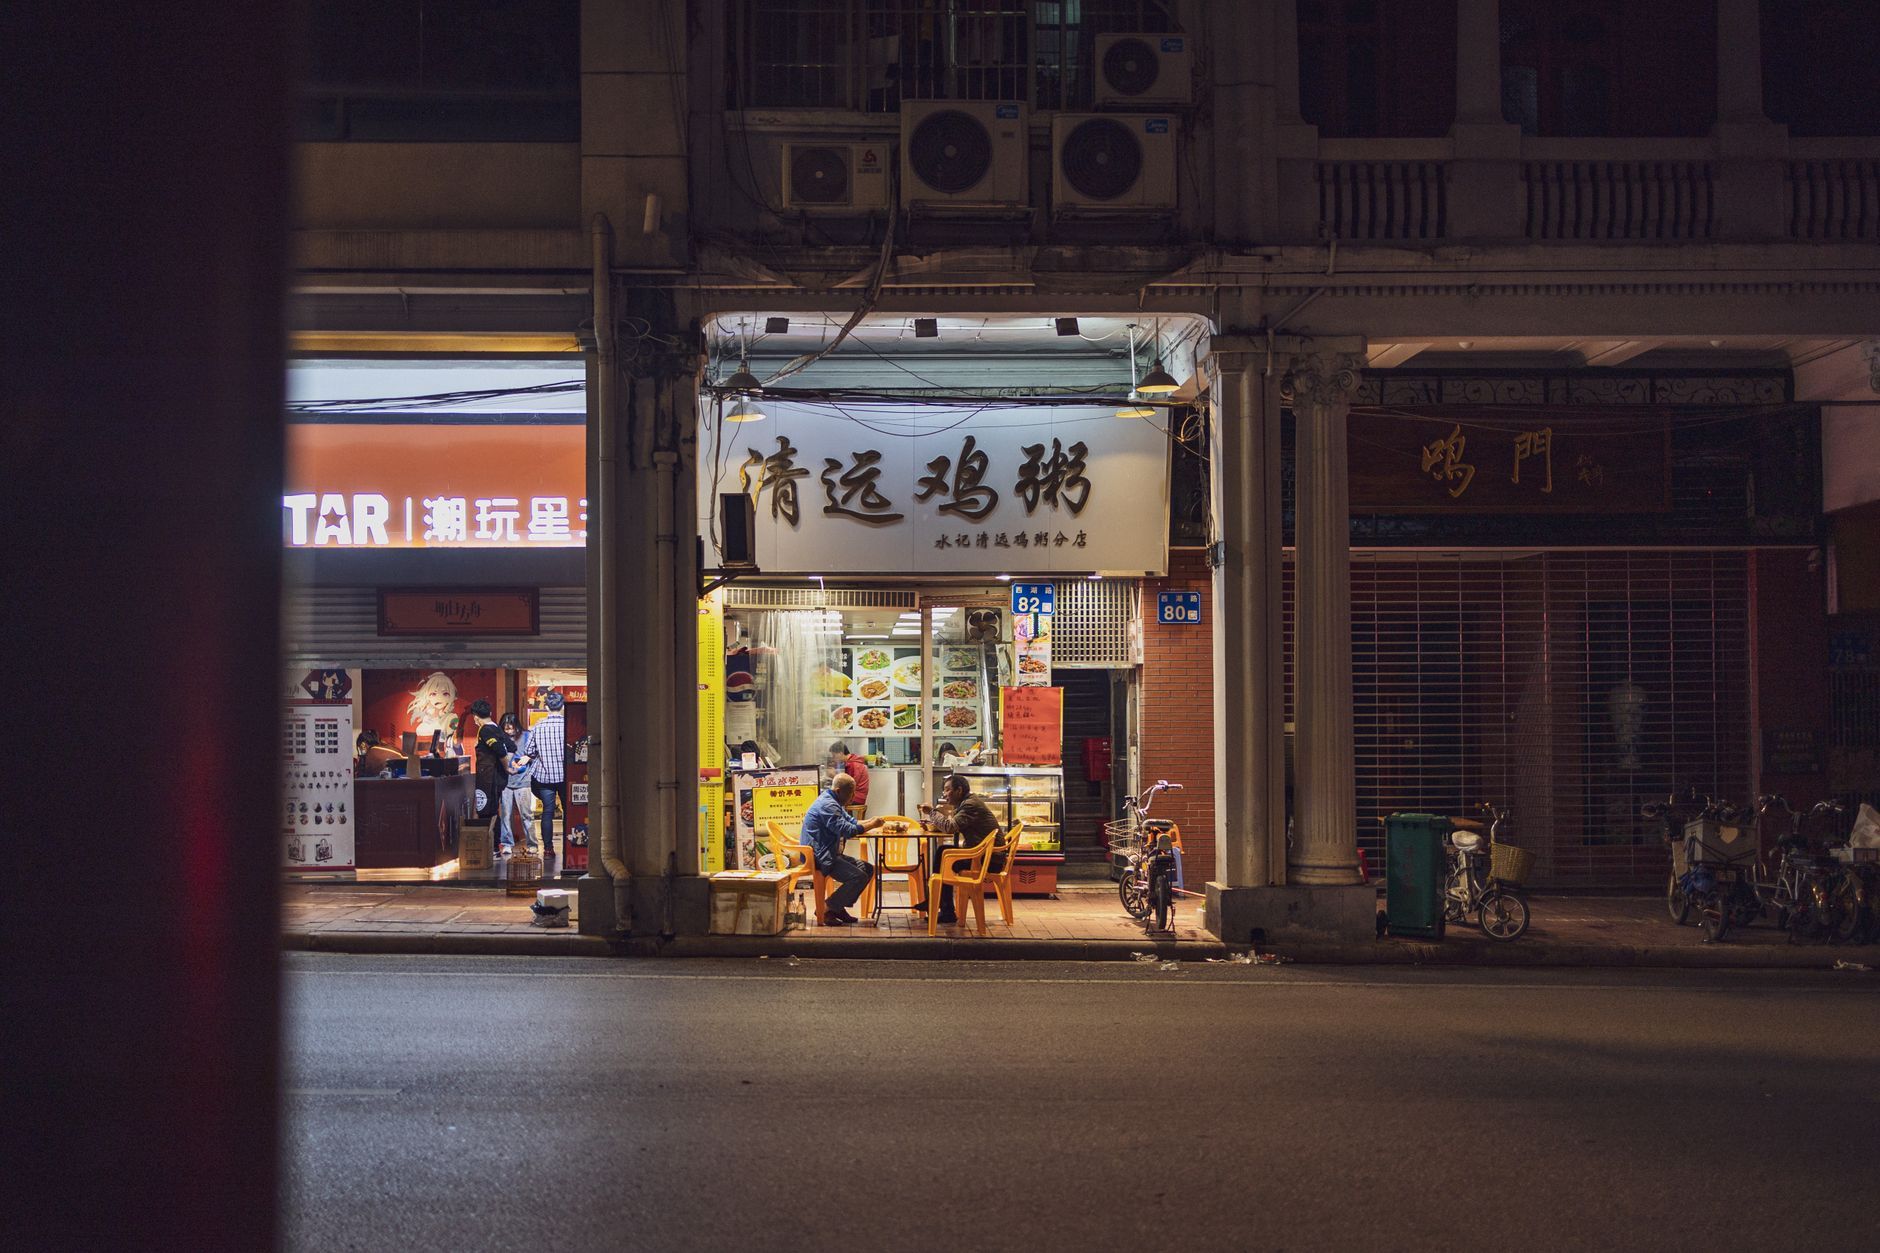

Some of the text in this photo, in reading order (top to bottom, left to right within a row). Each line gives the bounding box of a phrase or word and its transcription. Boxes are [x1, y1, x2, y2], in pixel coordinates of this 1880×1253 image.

[740, 435, 1092, 528] 清远鸡粥
[423, 496, 588, 542] 潮玩星
[934, 530, 1088, 549] 水记清远鸡粥分店
[1018, 597, 1040, 612] 82
[1164, 605, 1186, 620] 80
